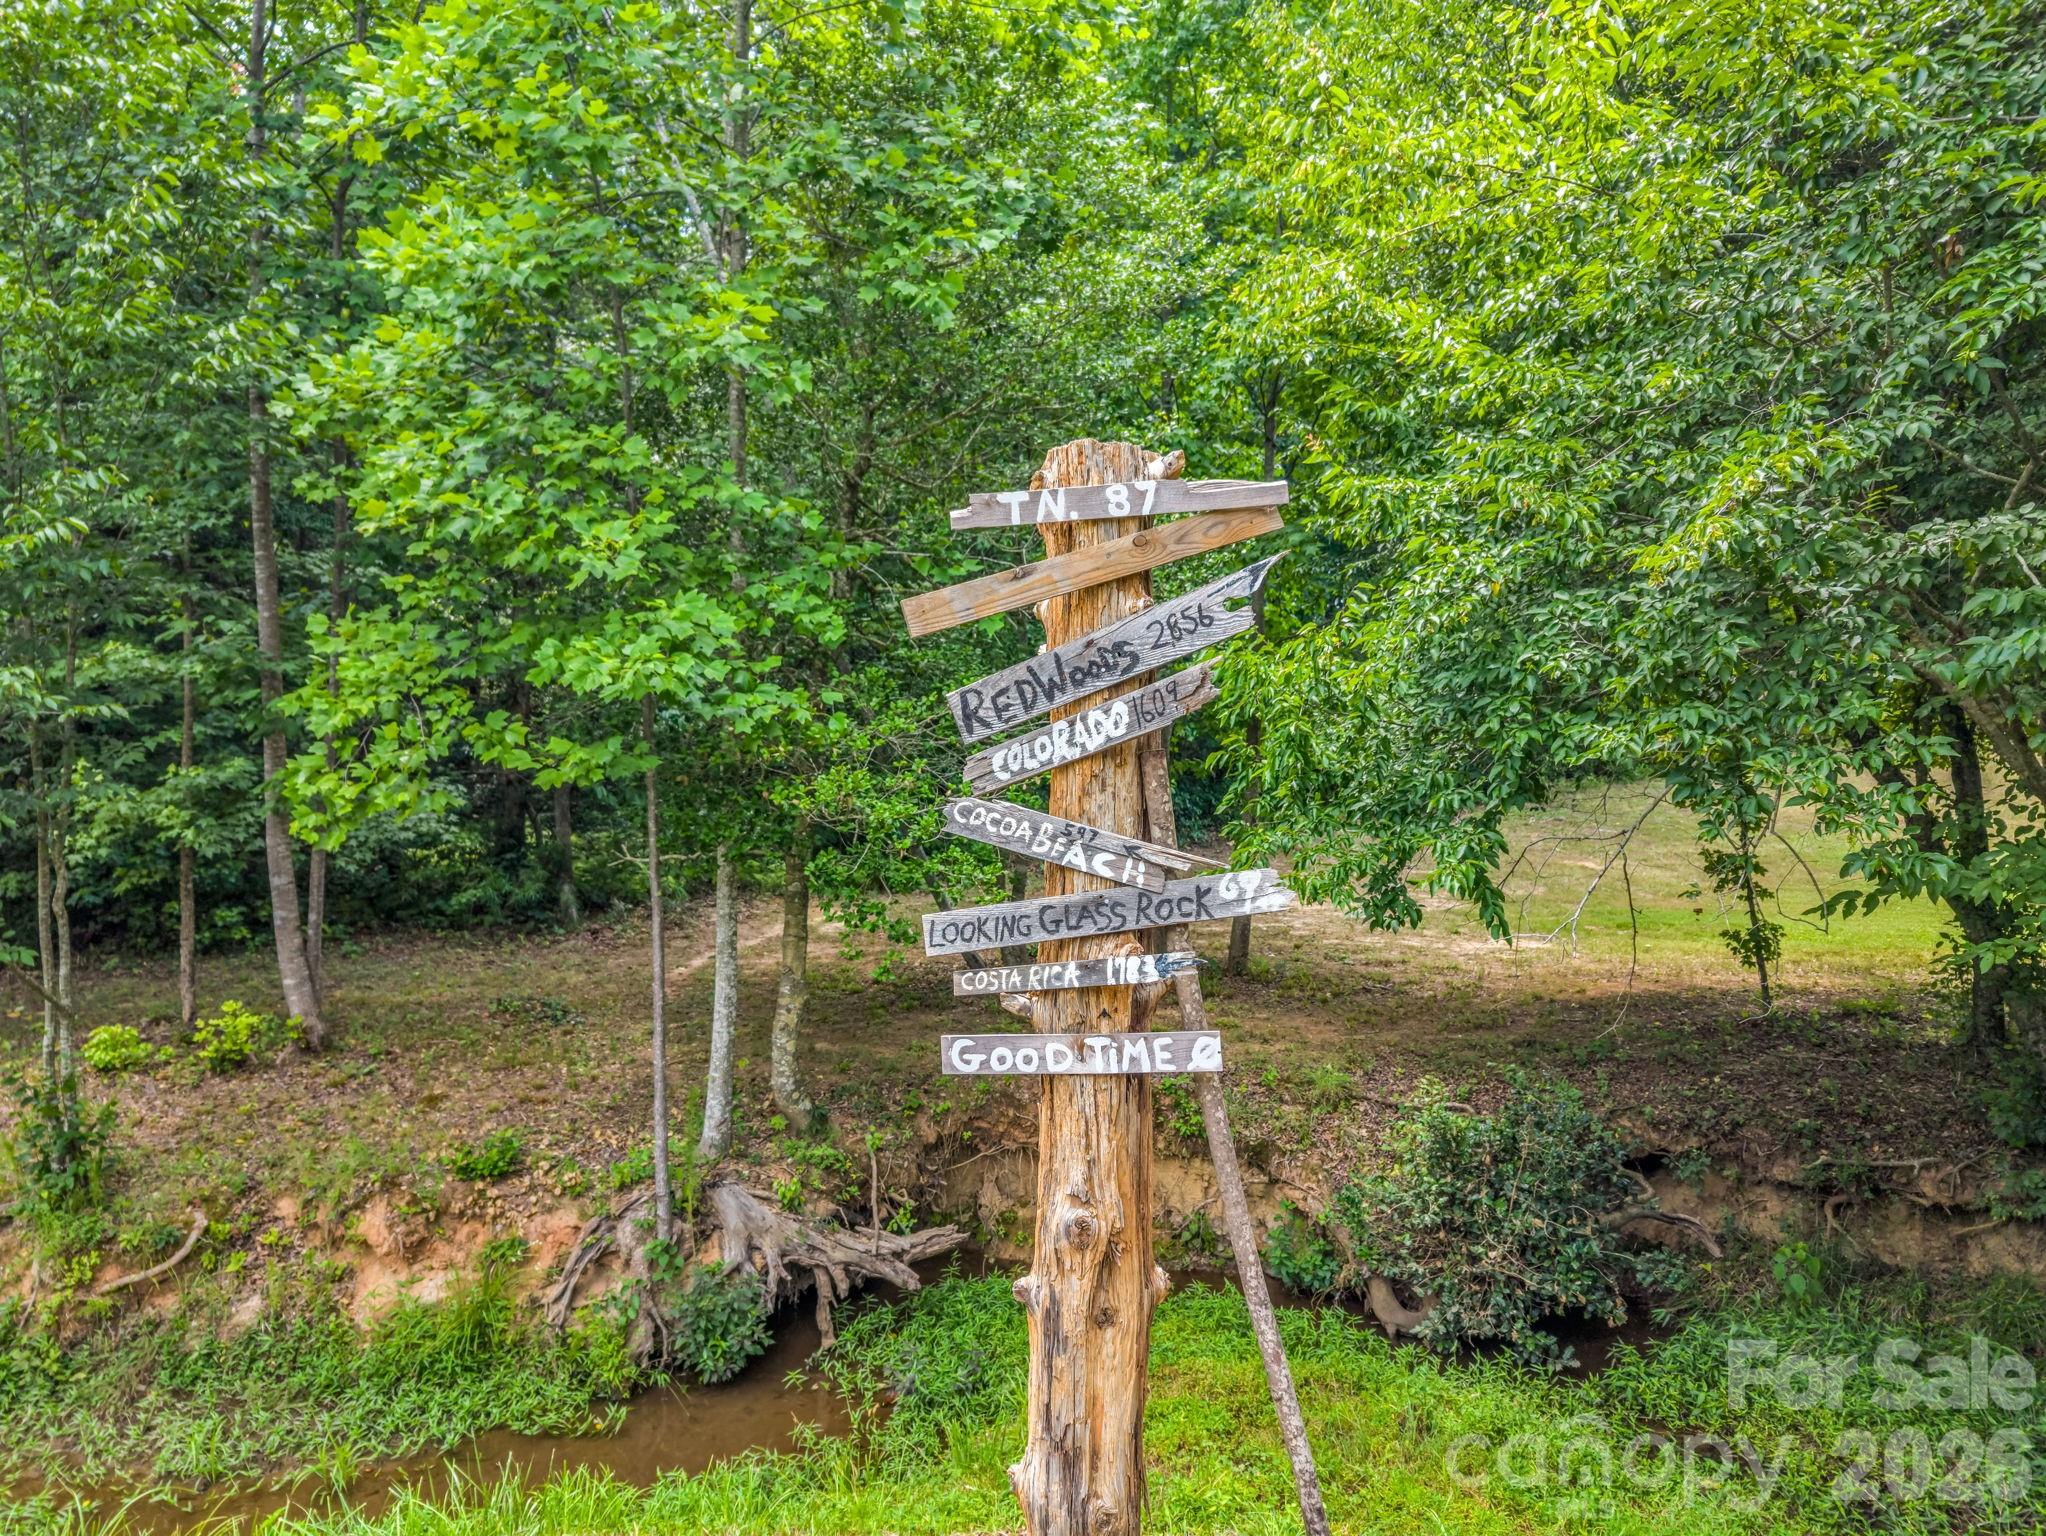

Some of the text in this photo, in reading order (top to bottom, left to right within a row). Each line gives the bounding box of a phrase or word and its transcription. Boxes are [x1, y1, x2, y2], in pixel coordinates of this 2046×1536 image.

[1105, 480, 1158, 517] 87
[991, 679, 1178, 781] COLORADO 1609
[1059, 823, 1099, 843] 597
[928, 912, 1033, 949] LOOKING
[1038, 897, 1128, 936] GLASS
[1134, 884, 1215, 927] ROCK
[960, 955, 1159, 992] COSTA RICA 1783
[949, 1038, 1073, 1074] GOOD
